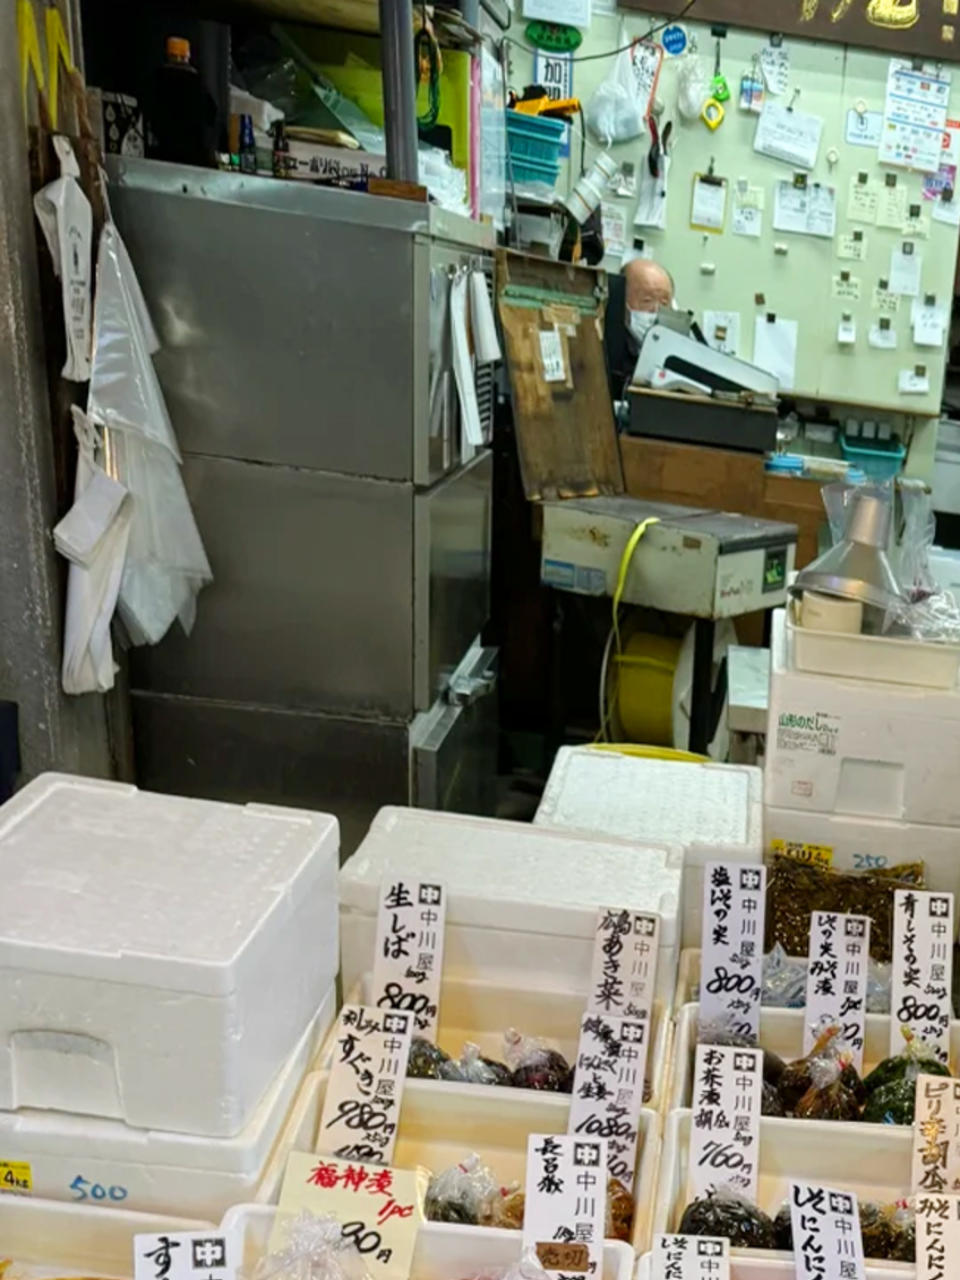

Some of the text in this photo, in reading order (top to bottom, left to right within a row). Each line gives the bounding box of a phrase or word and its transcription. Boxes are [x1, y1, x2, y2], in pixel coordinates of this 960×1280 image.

[852, 852, 888, 869] 250
[382, 881, 416, 959] 生しば
[898, 892, 923, 989] 青しその実
[706, 966, 762, 1001] 800円
[896, 995, 950, 1029] 800円
[337, 1033, 373, 1096] すぐき
[326, 1100, 397, 1136] 980円
[575, 1113, 637, 1144] 1080円
[697, 1140, 753, 1174] 760円
[69, 1174, 128, 1201] 500
[306, 1159, 395, 1198] 福神漬
[376, 1198, 415, 1226] 1pc
